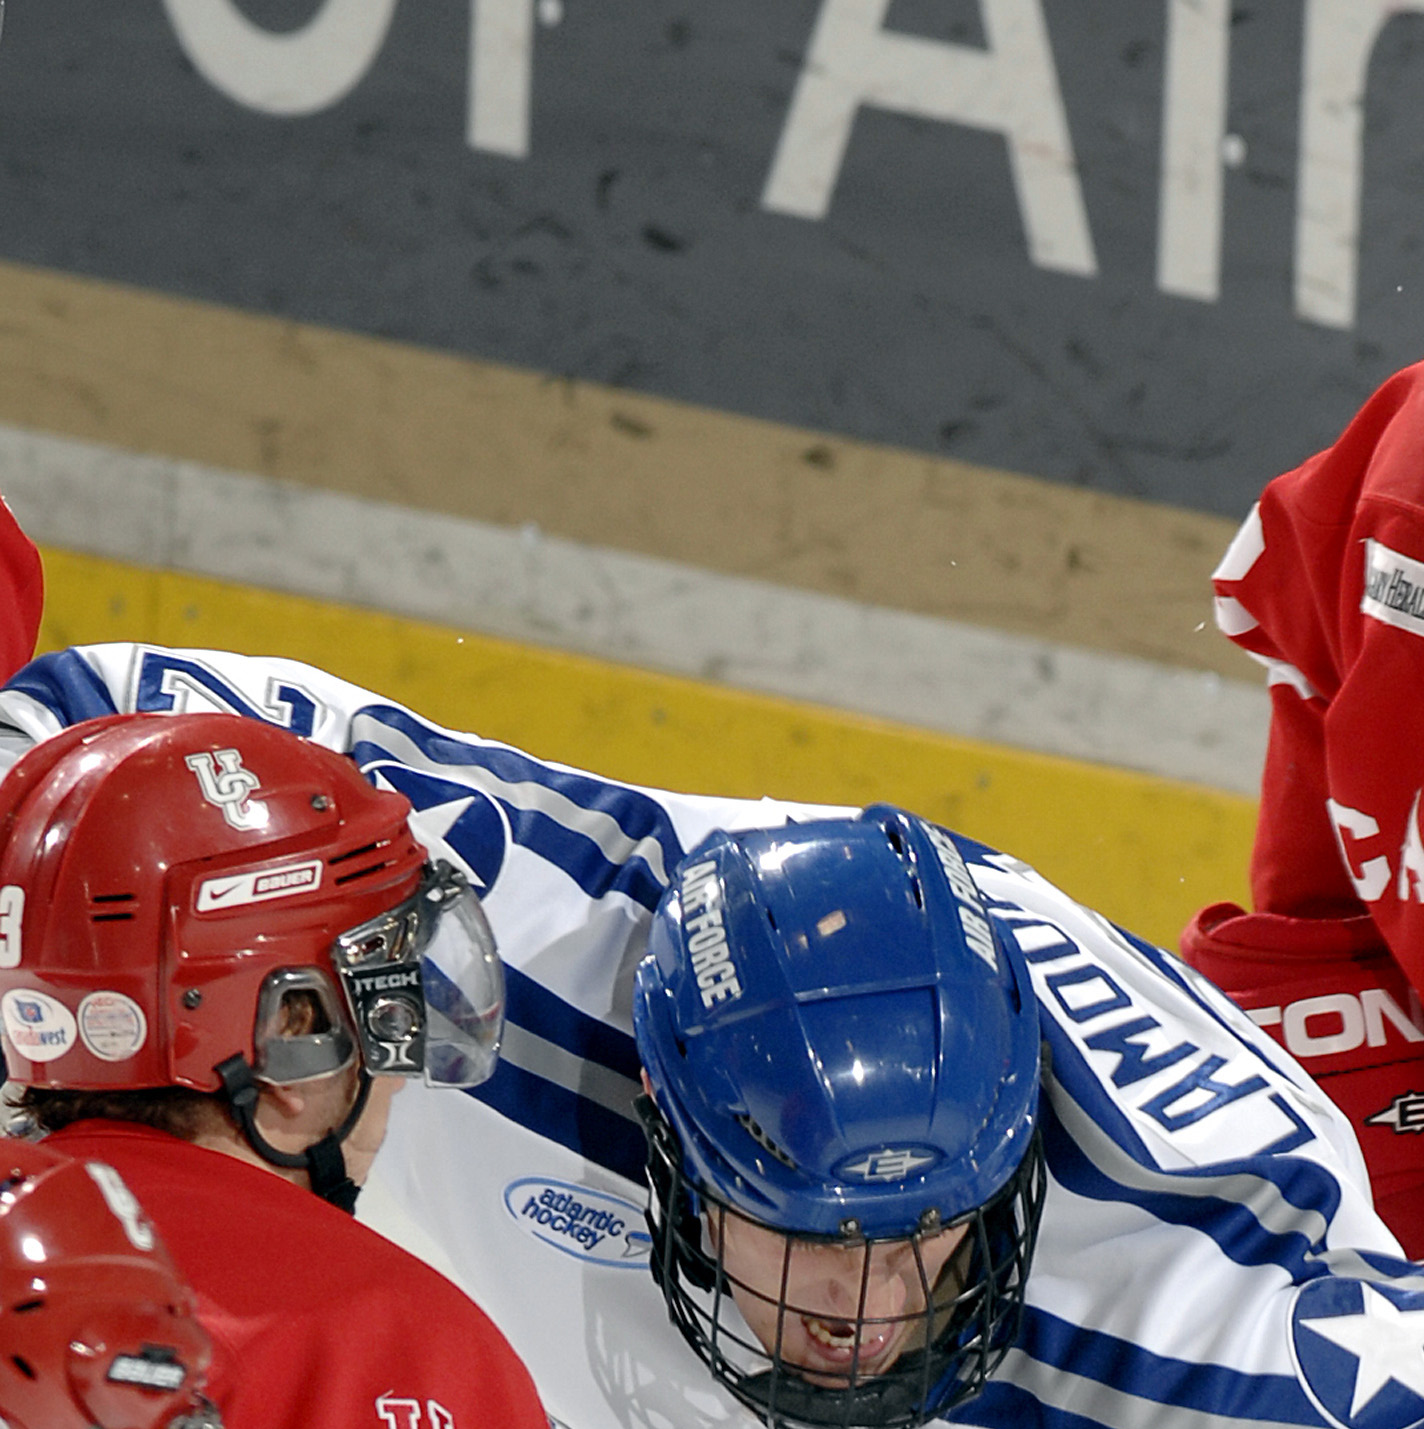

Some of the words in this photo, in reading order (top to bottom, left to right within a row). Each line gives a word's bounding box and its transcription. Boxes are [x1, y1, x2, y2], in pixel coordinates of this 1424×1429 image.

[686, 908, 743, 1009] FORCE
[982, 886, 1317, 1156] LAMOU
[521, 1196, 606, 1251] hockey
[538, 1188, 625, 1237] atlantic
